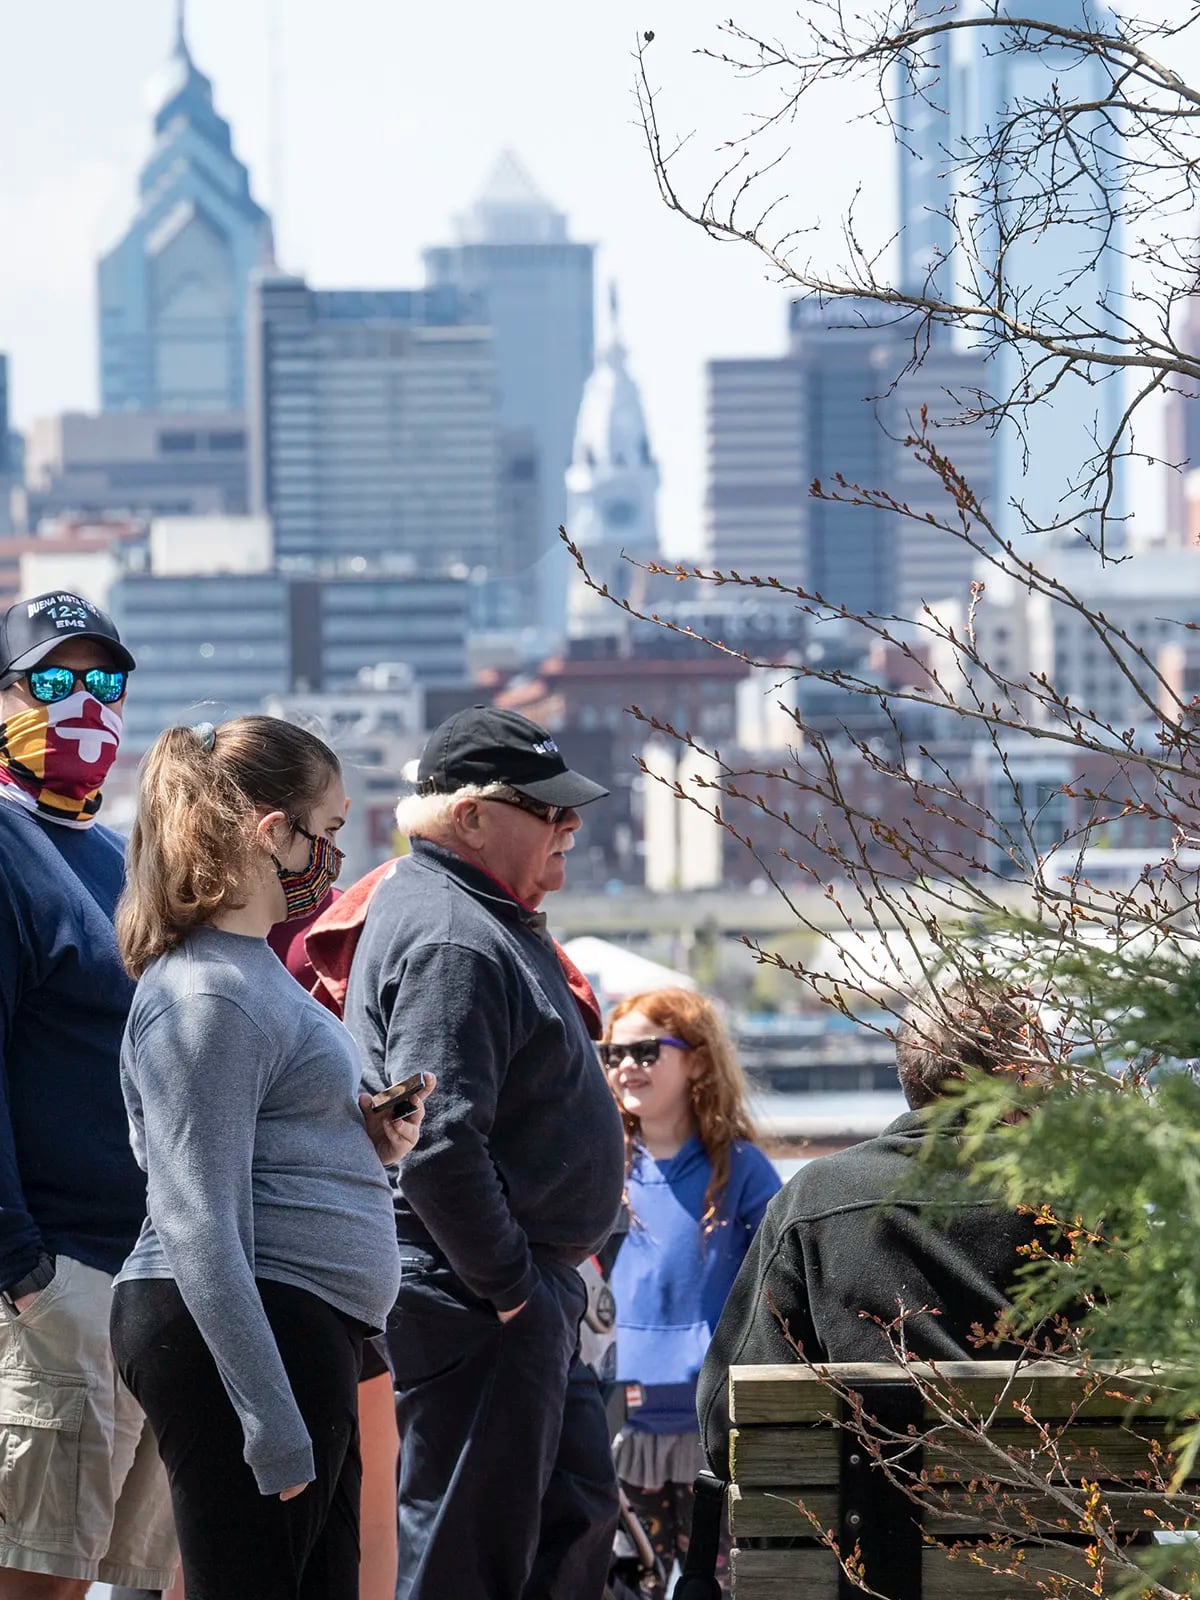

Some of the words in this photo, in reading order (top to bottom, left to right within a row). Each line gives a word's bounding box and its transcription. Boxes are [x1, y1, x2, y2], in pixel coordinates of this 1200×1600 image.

[27, 597, 56, 618] BUENA
[57, 594, 81, 606] VISTA
[47, 605, 88, 619] 12-9
[55, 619, 86, 629] EMS
